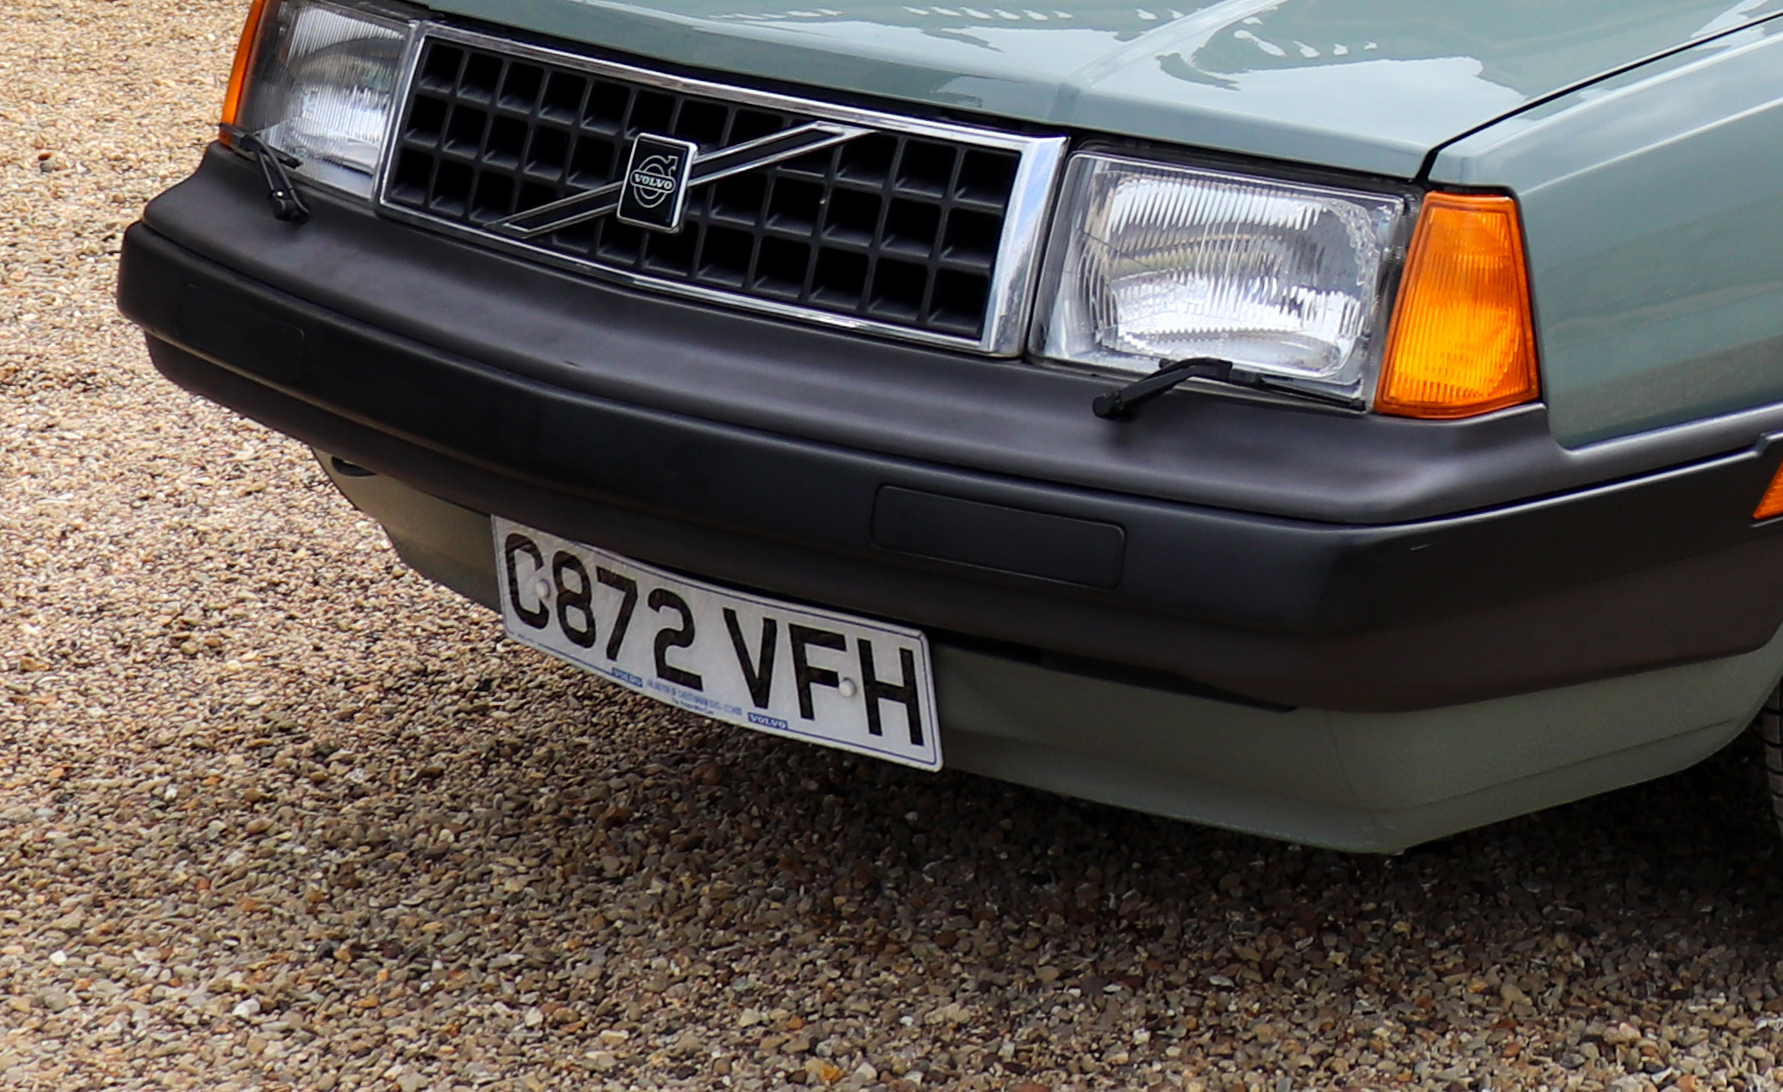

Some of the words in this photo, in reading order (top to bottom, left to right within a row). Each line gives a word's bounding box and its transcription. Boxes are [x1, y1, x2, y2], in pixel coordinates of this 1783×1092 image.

[633, 173, 673, 190] VOLVO
[504, 532, 704, 692] C872
[722, 606, 926, 747] VFH
[749, 713, 788, 729] VOLVO
